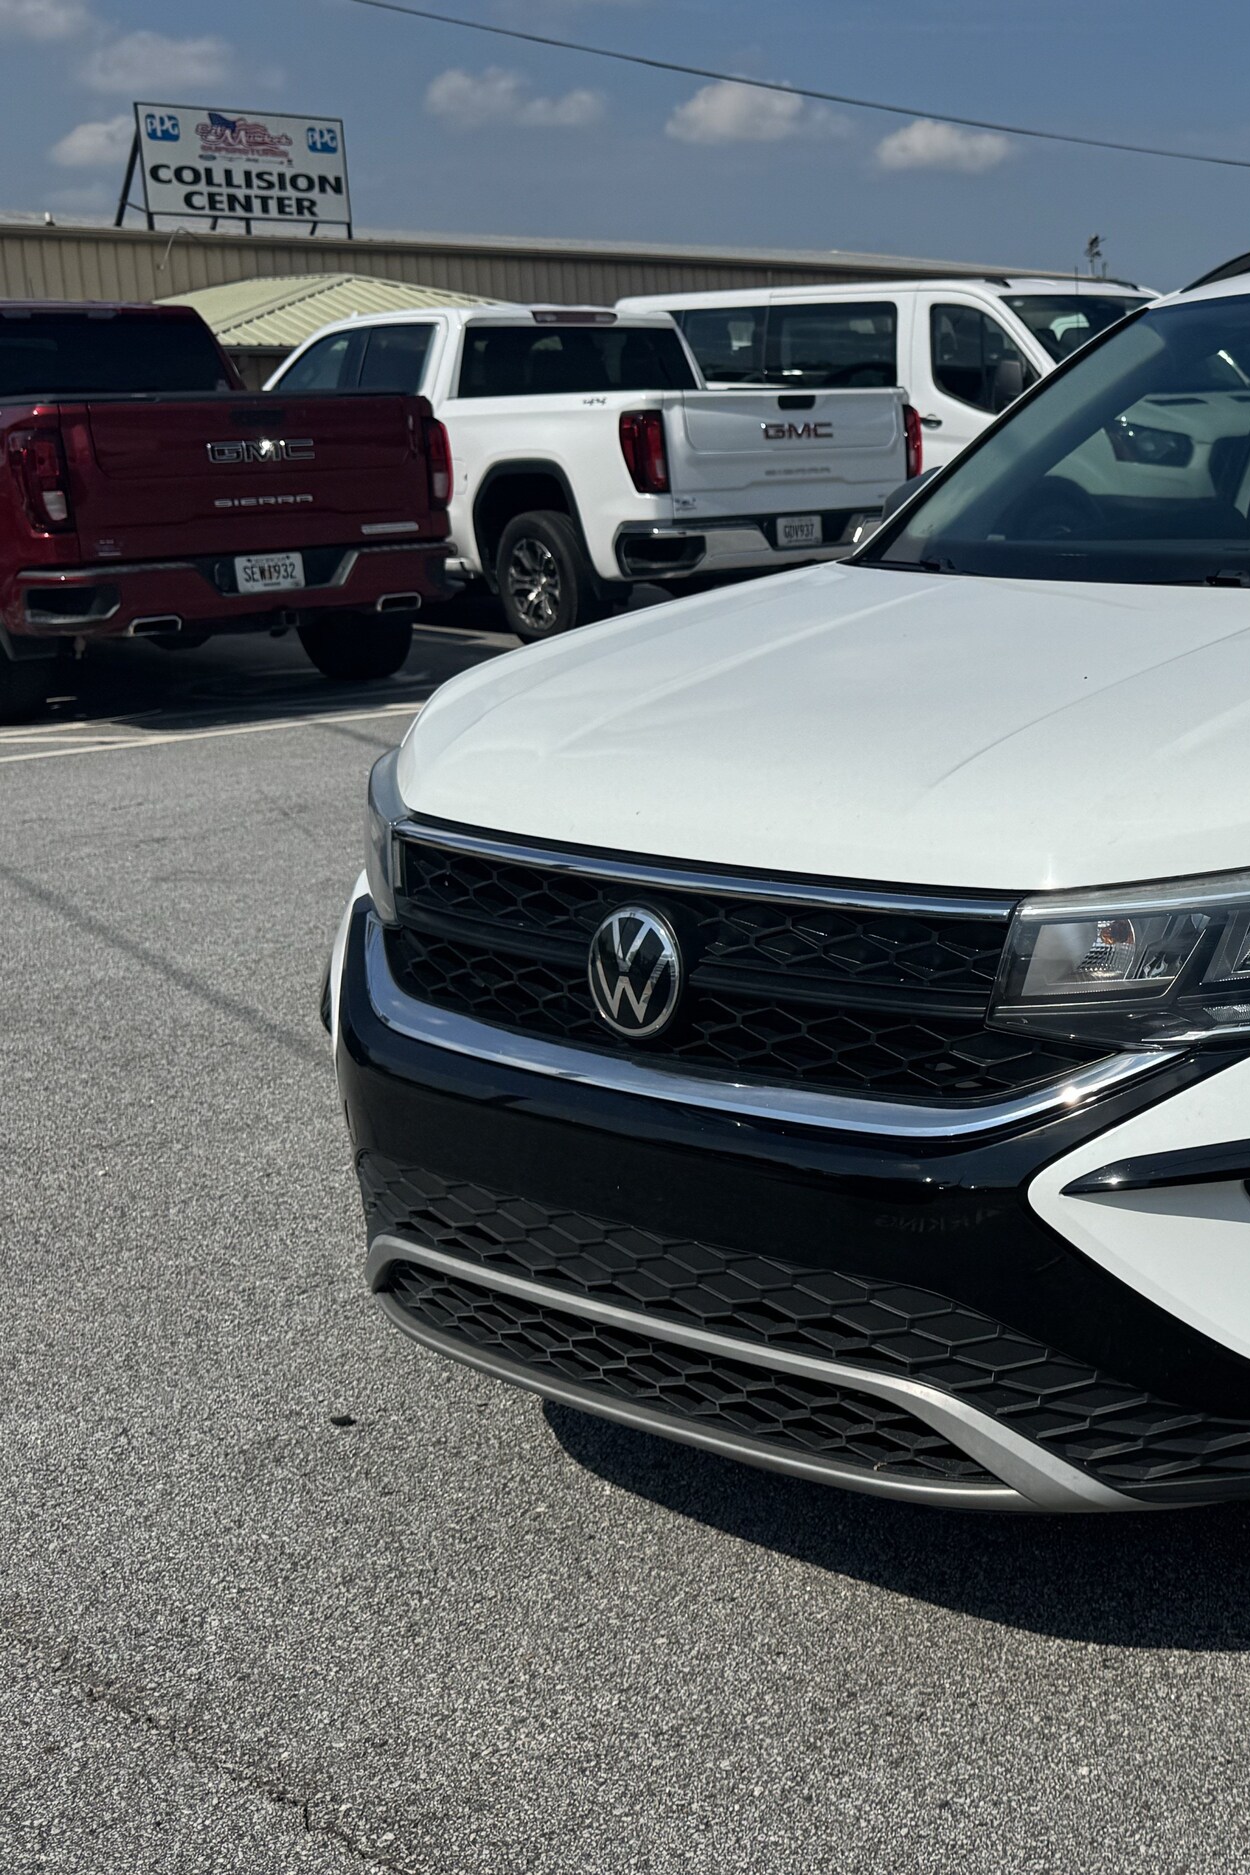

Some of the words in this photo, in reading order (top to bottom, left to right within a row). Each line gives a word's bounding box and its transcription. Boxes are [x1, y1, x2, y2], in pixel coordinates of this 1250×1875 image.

[147, 113, 179, 138] PPG
[308, 128, 338, 151] PPG
[149, 164, 343, 194] COLLISION
[184, 191, 318, 217] CENTER
[762, 422, 834, 440] GMC
[206, 438, 316, 464] GMC
[213, 493, 314, 508] SIERRA
